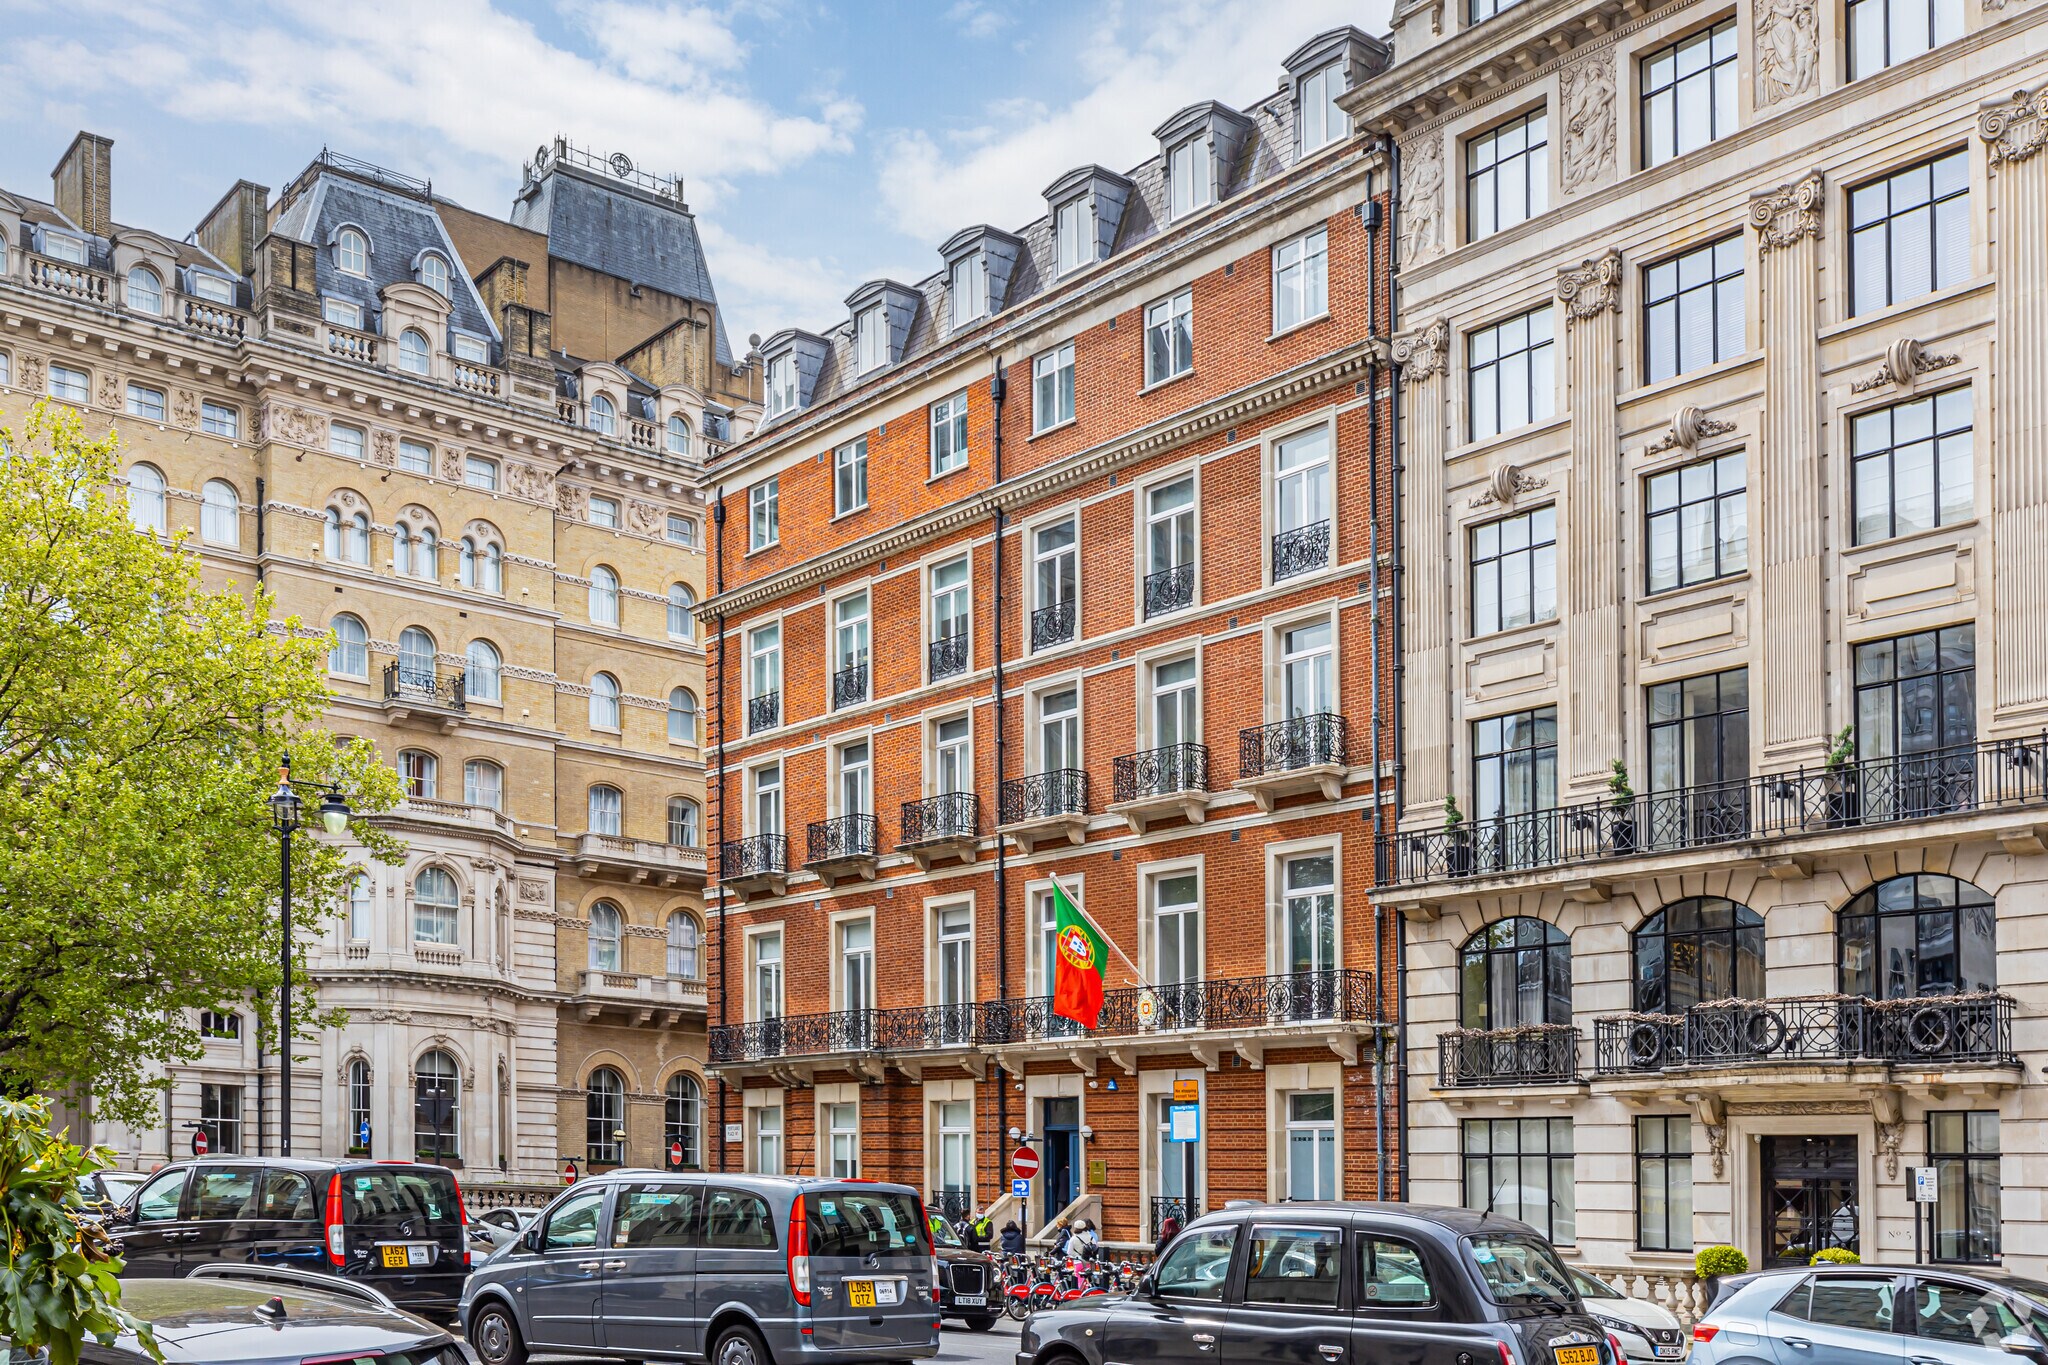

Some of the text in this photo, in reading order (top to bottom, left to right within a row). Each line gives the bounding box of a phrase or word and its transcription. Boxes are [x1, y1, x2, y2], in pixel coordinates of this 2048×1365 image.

[1906, 1231, 1912, 1240] 5
[384, 1246, 405, 1256] LA62
[388, 1256, 404, 1266] EEB
[850, 1282, 871, 1293] LD63
[855, 1294, 871, 1304] OTZ
[1557, 1349, 1595, 1364] LS62 BJO
